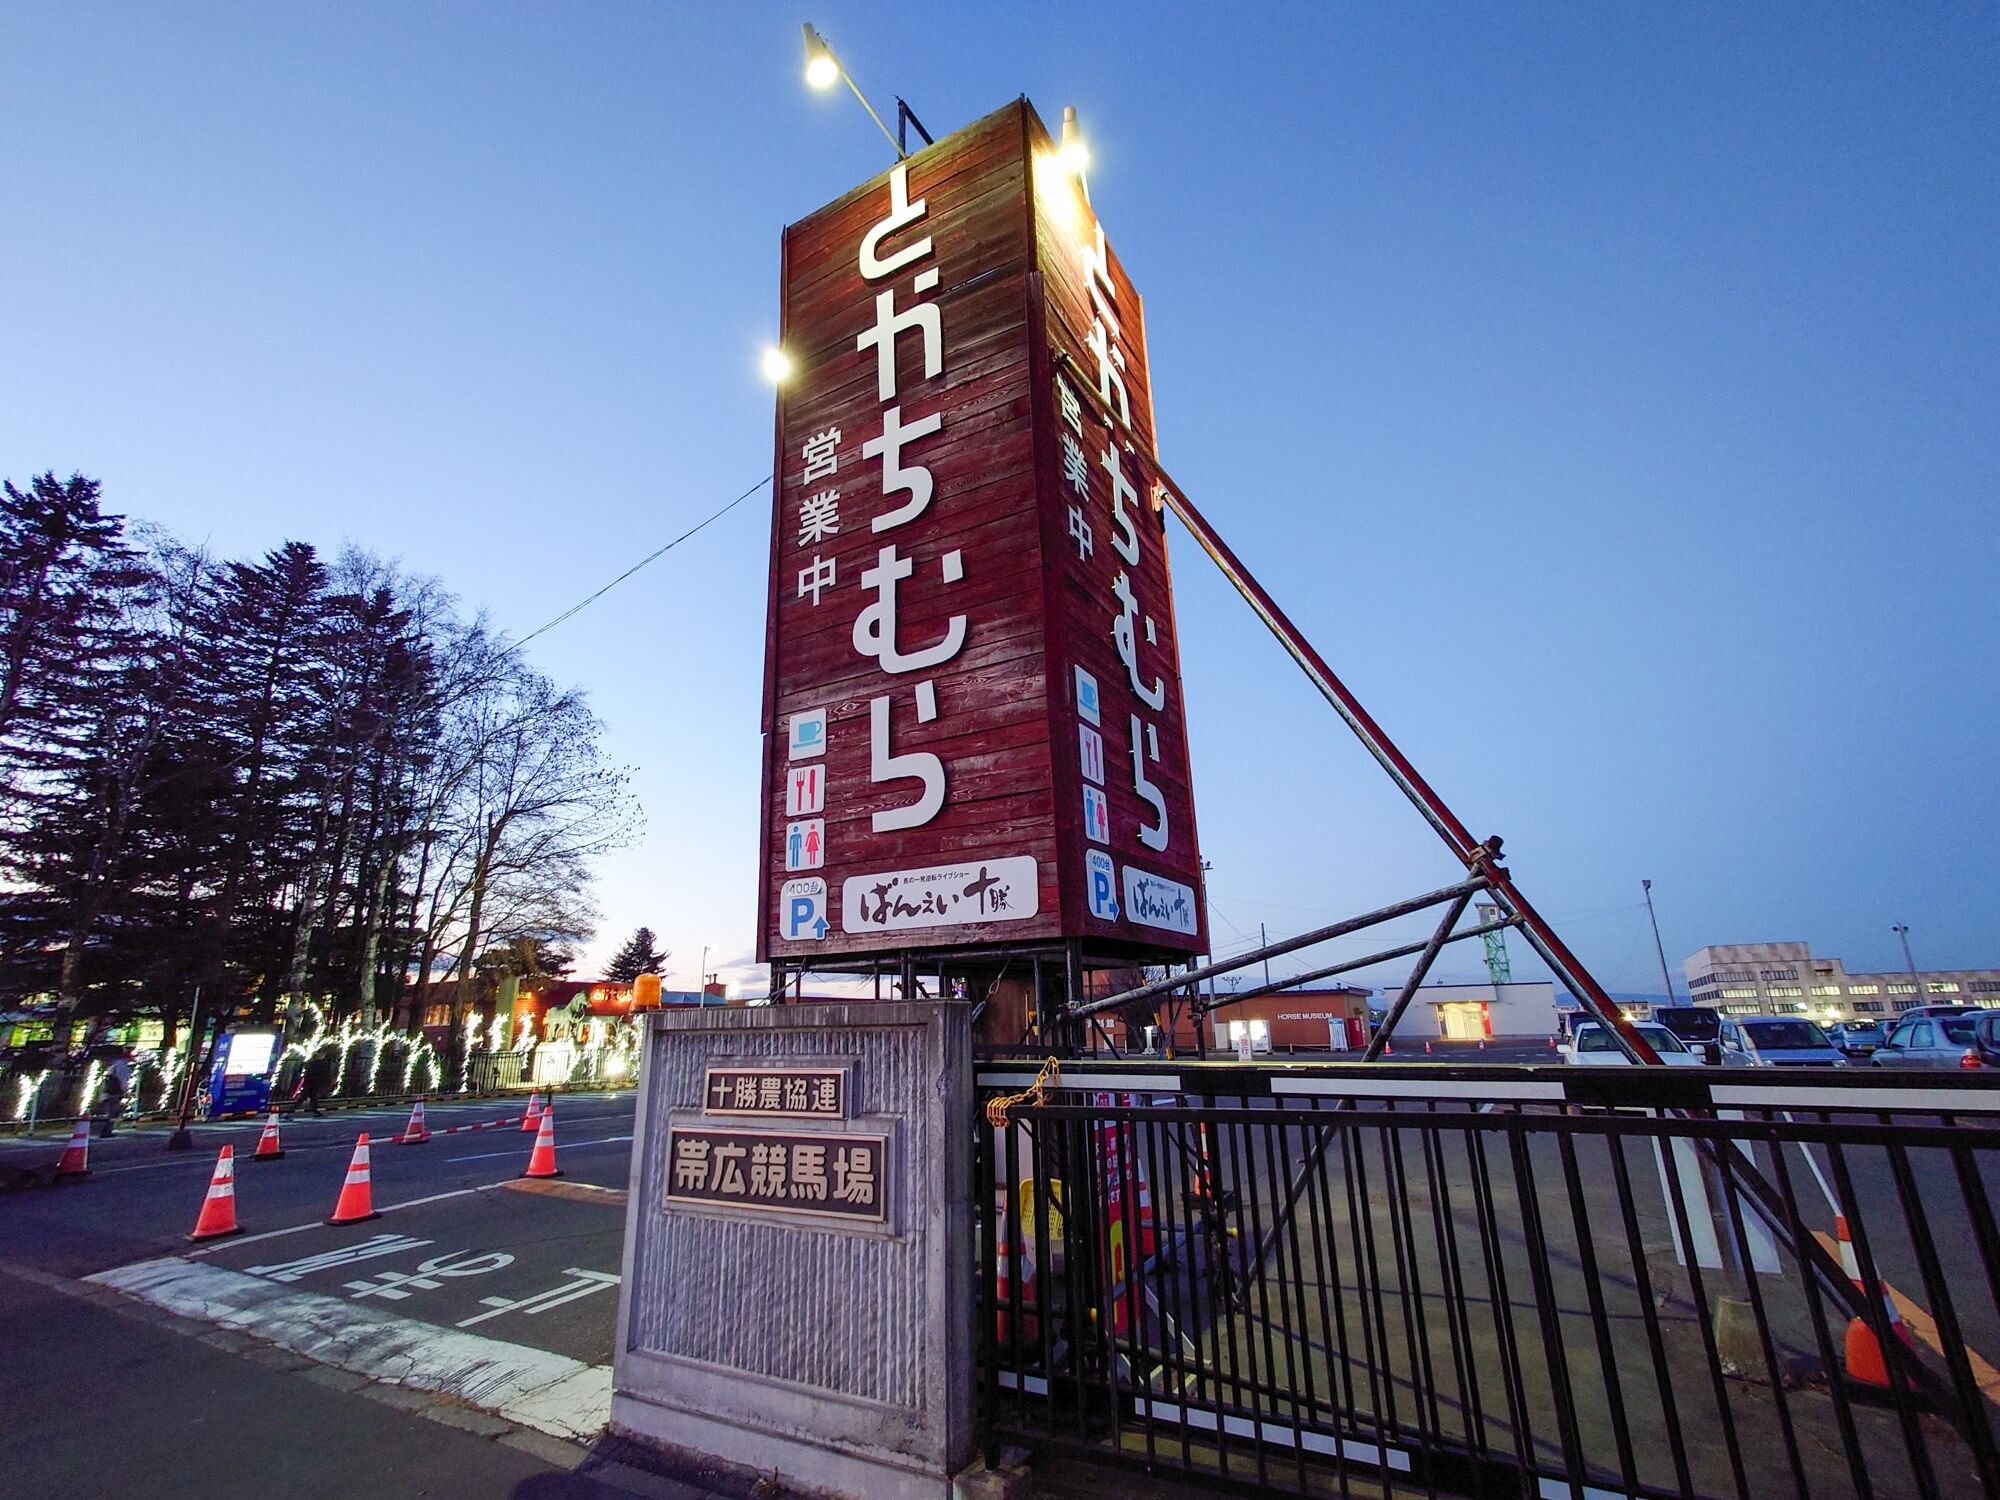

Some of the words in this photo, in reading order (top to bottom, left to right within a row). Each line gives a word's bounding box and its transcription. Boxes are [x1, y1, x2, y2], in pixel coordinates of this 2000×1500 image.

[1056, 372, 1095, 562] 営業中
[797, 426, 844, 607] 営業中
[853, 165, 968, 834] とかちむら
[789, 882, 820, 895] 400台
[790, 898, 815, 937] P
[860, 866, 1015, 925] ばんえい十勝
[711, 1076, 838, 1112] 十勝農協連
[674, 1138, 876, 1205] 帯広競馬場
